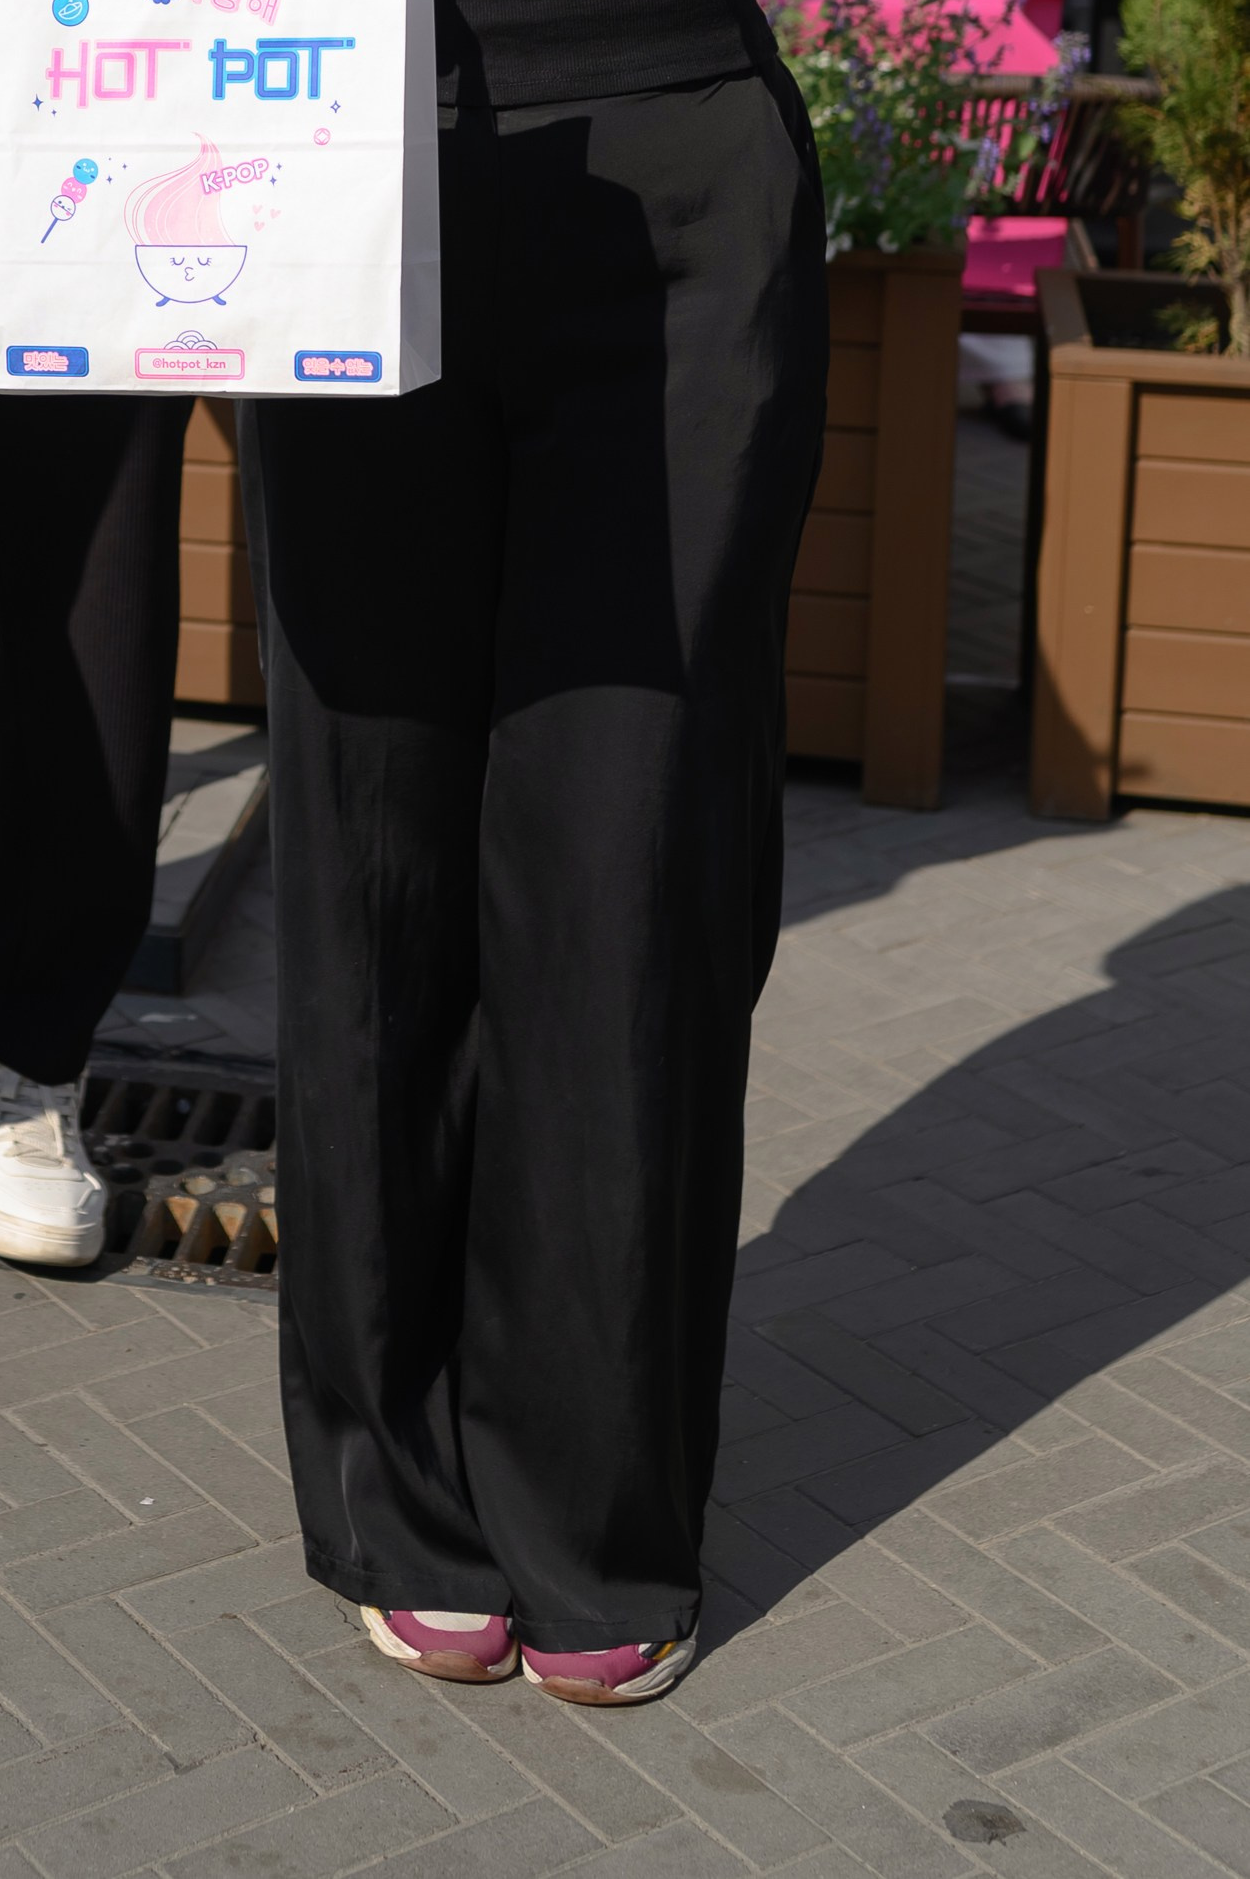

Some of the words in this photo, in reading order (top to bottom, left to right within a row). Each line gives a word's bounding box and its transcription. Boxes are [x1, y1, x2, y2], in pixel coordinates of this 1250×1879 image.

[45, 39, 192, 109] HOT
[208, 37, 355, 100] POT
[200, 158, 269, 194] K-POP
[152, 357, 226, 372] @hotpot_kzn
